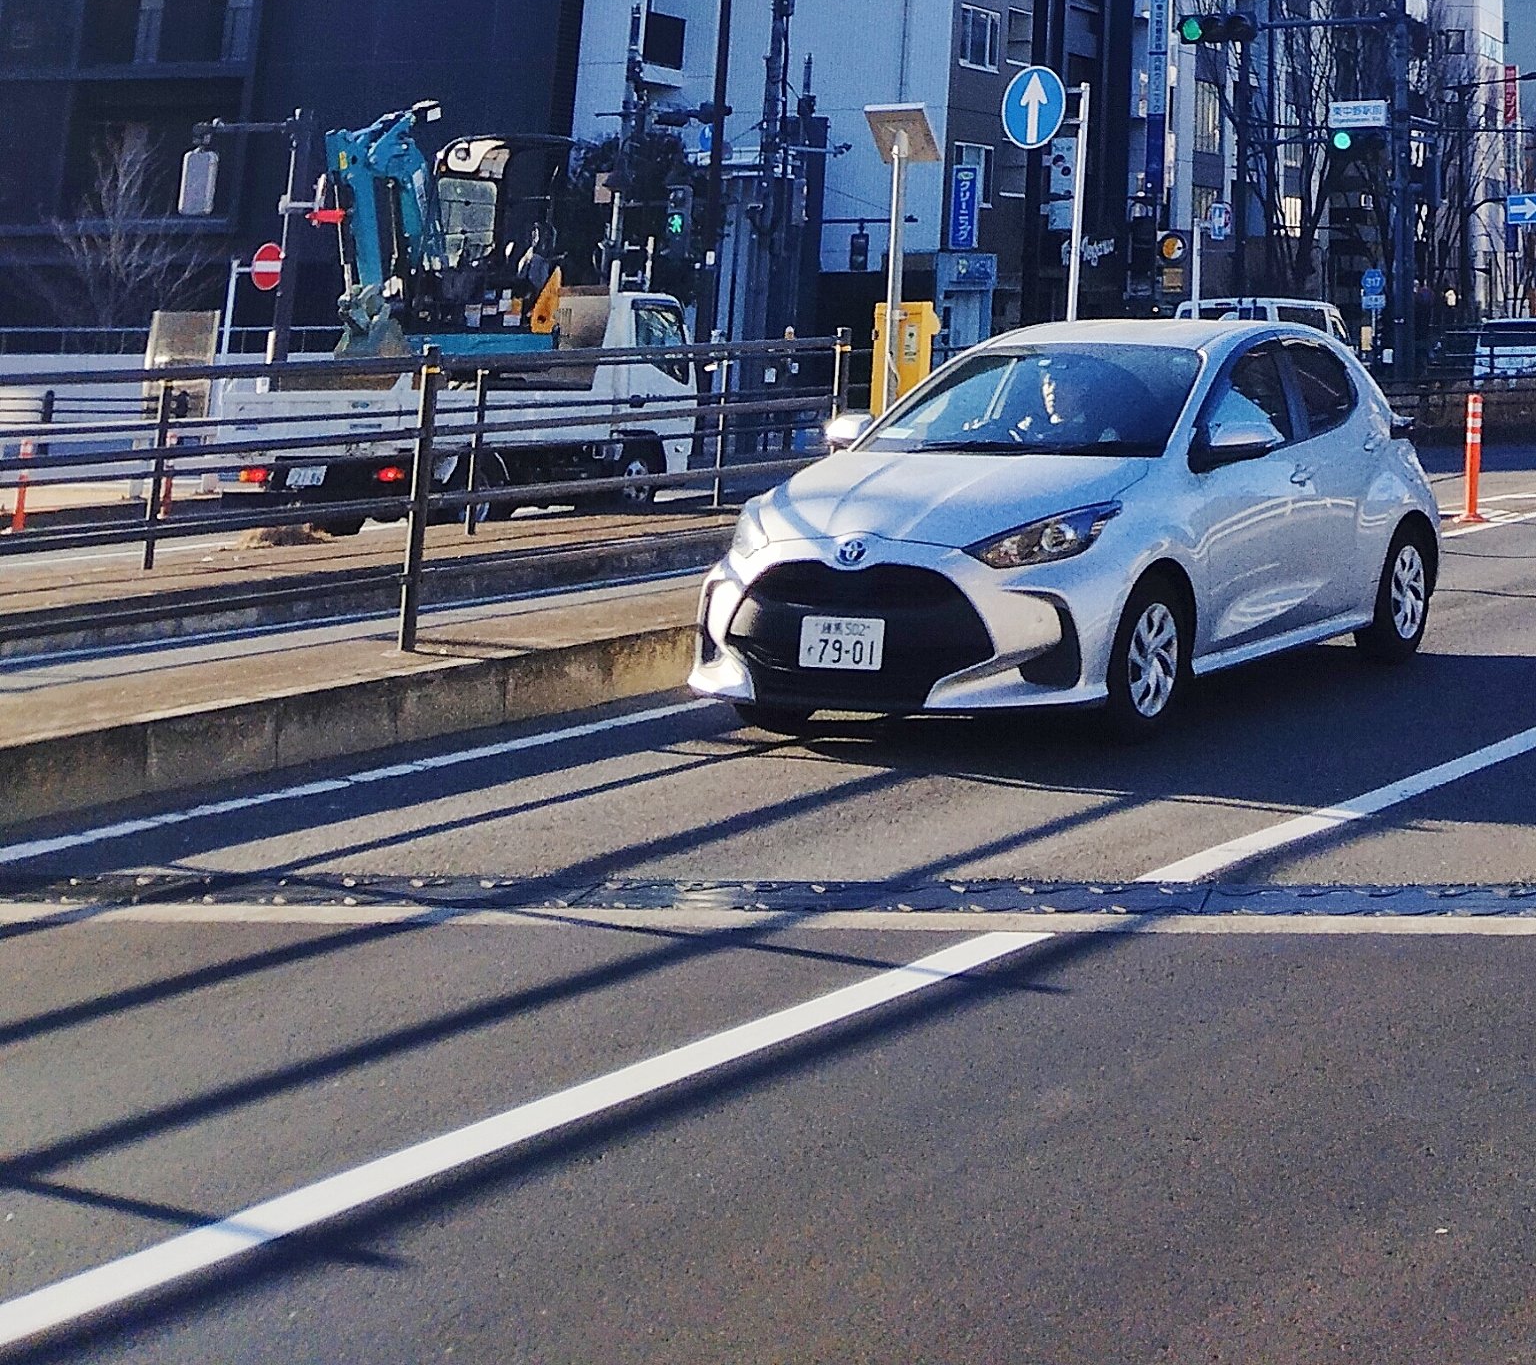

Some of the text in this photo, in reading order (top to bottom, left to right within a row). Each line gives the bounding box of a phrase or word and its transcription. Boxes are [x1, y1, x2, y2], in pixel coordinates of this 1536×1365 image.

[958, 181, 971, 240] クリーニング
[1366, 277, 1380, 287] 317
[819, 639, 874, 665] 79-01
